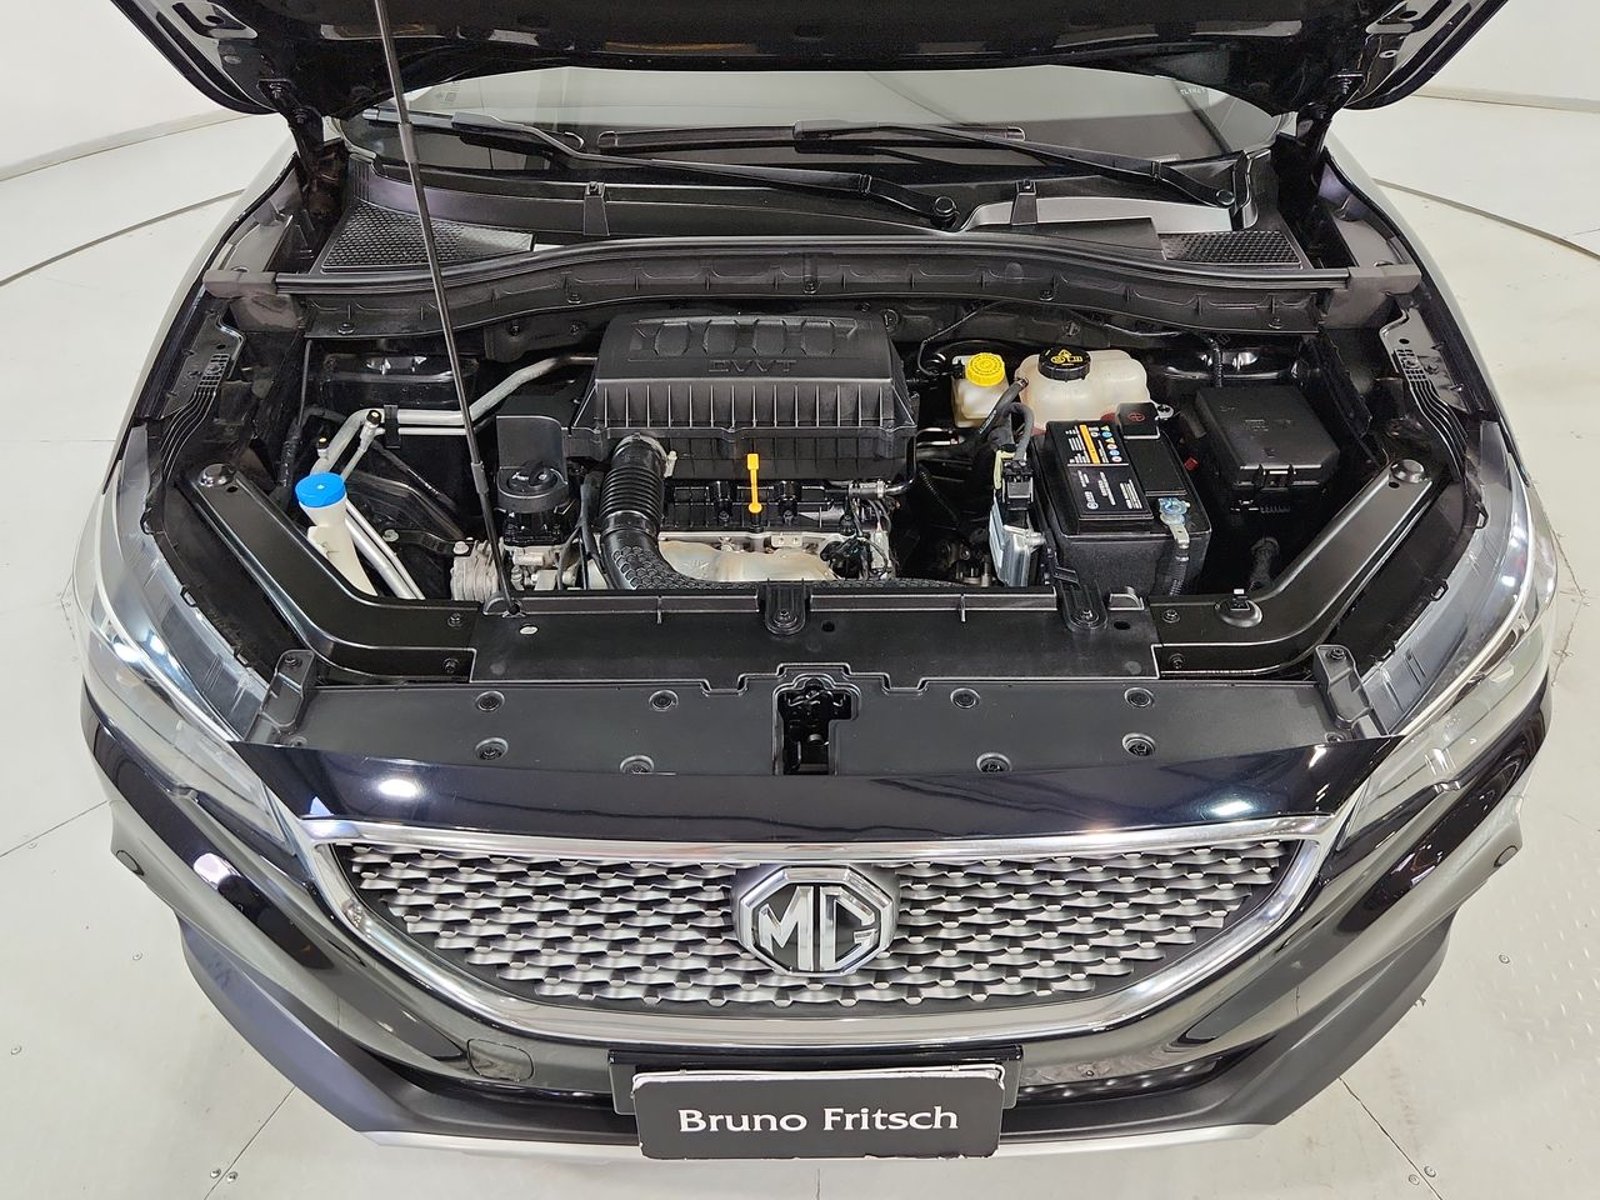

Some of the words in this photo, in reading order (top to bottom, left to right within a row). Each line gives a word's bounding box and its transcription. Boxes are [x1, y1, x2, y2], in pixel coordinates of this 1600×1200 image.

[757, 885, 878, 972] MG
[678, 1108, 808, 1133] Bruno
[822, 1105, 959, 1132] Fritsch
